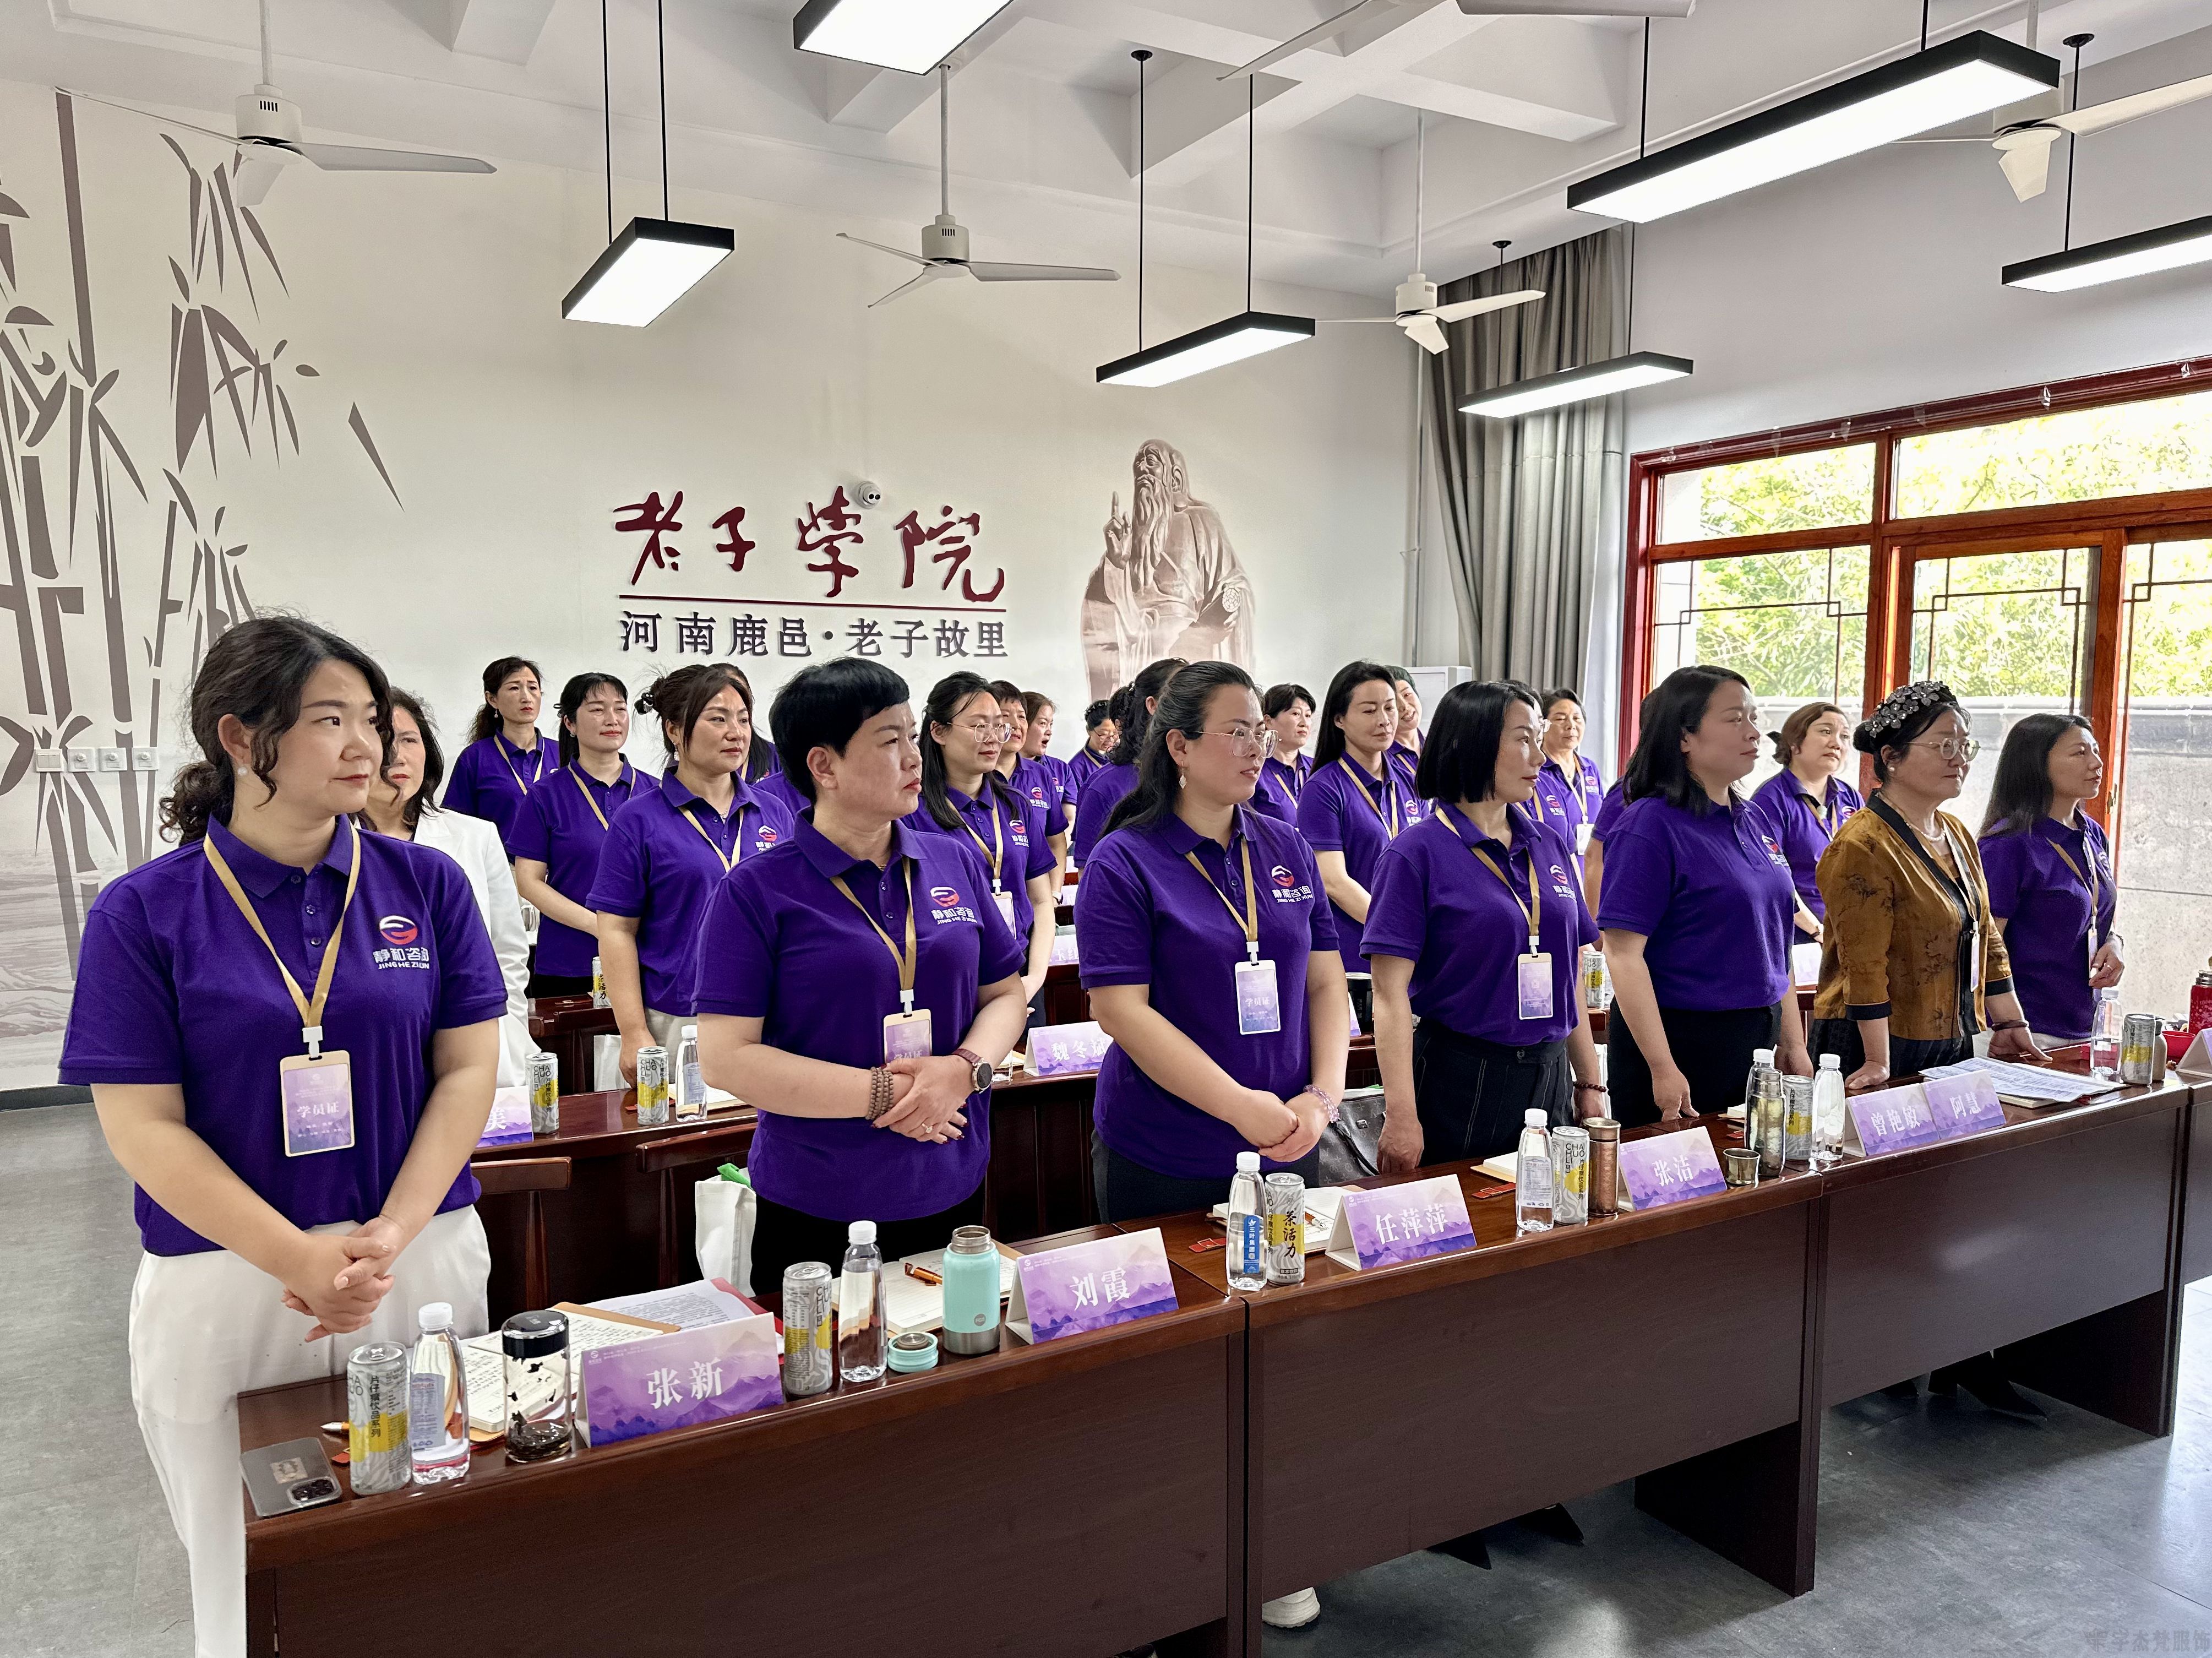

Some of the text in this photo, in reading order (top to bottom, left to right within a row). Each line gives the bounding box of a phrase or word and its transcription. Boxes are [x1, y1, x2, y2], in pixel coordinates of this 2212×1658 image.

[619, 610, 1009, 658] 河南鹿邑·老子故里
[1652, 1154, 1693, 1187] 张洁
[1283, 1210, 1296, 1258] 茶活力
[1376, 1203, 1448, 1245] 任萍萍
[817, 1293, 831, 1305] HU
[1069, 1266, 1131, 1311] 刘霞
[646, 1357, 723, 1409] 张新
